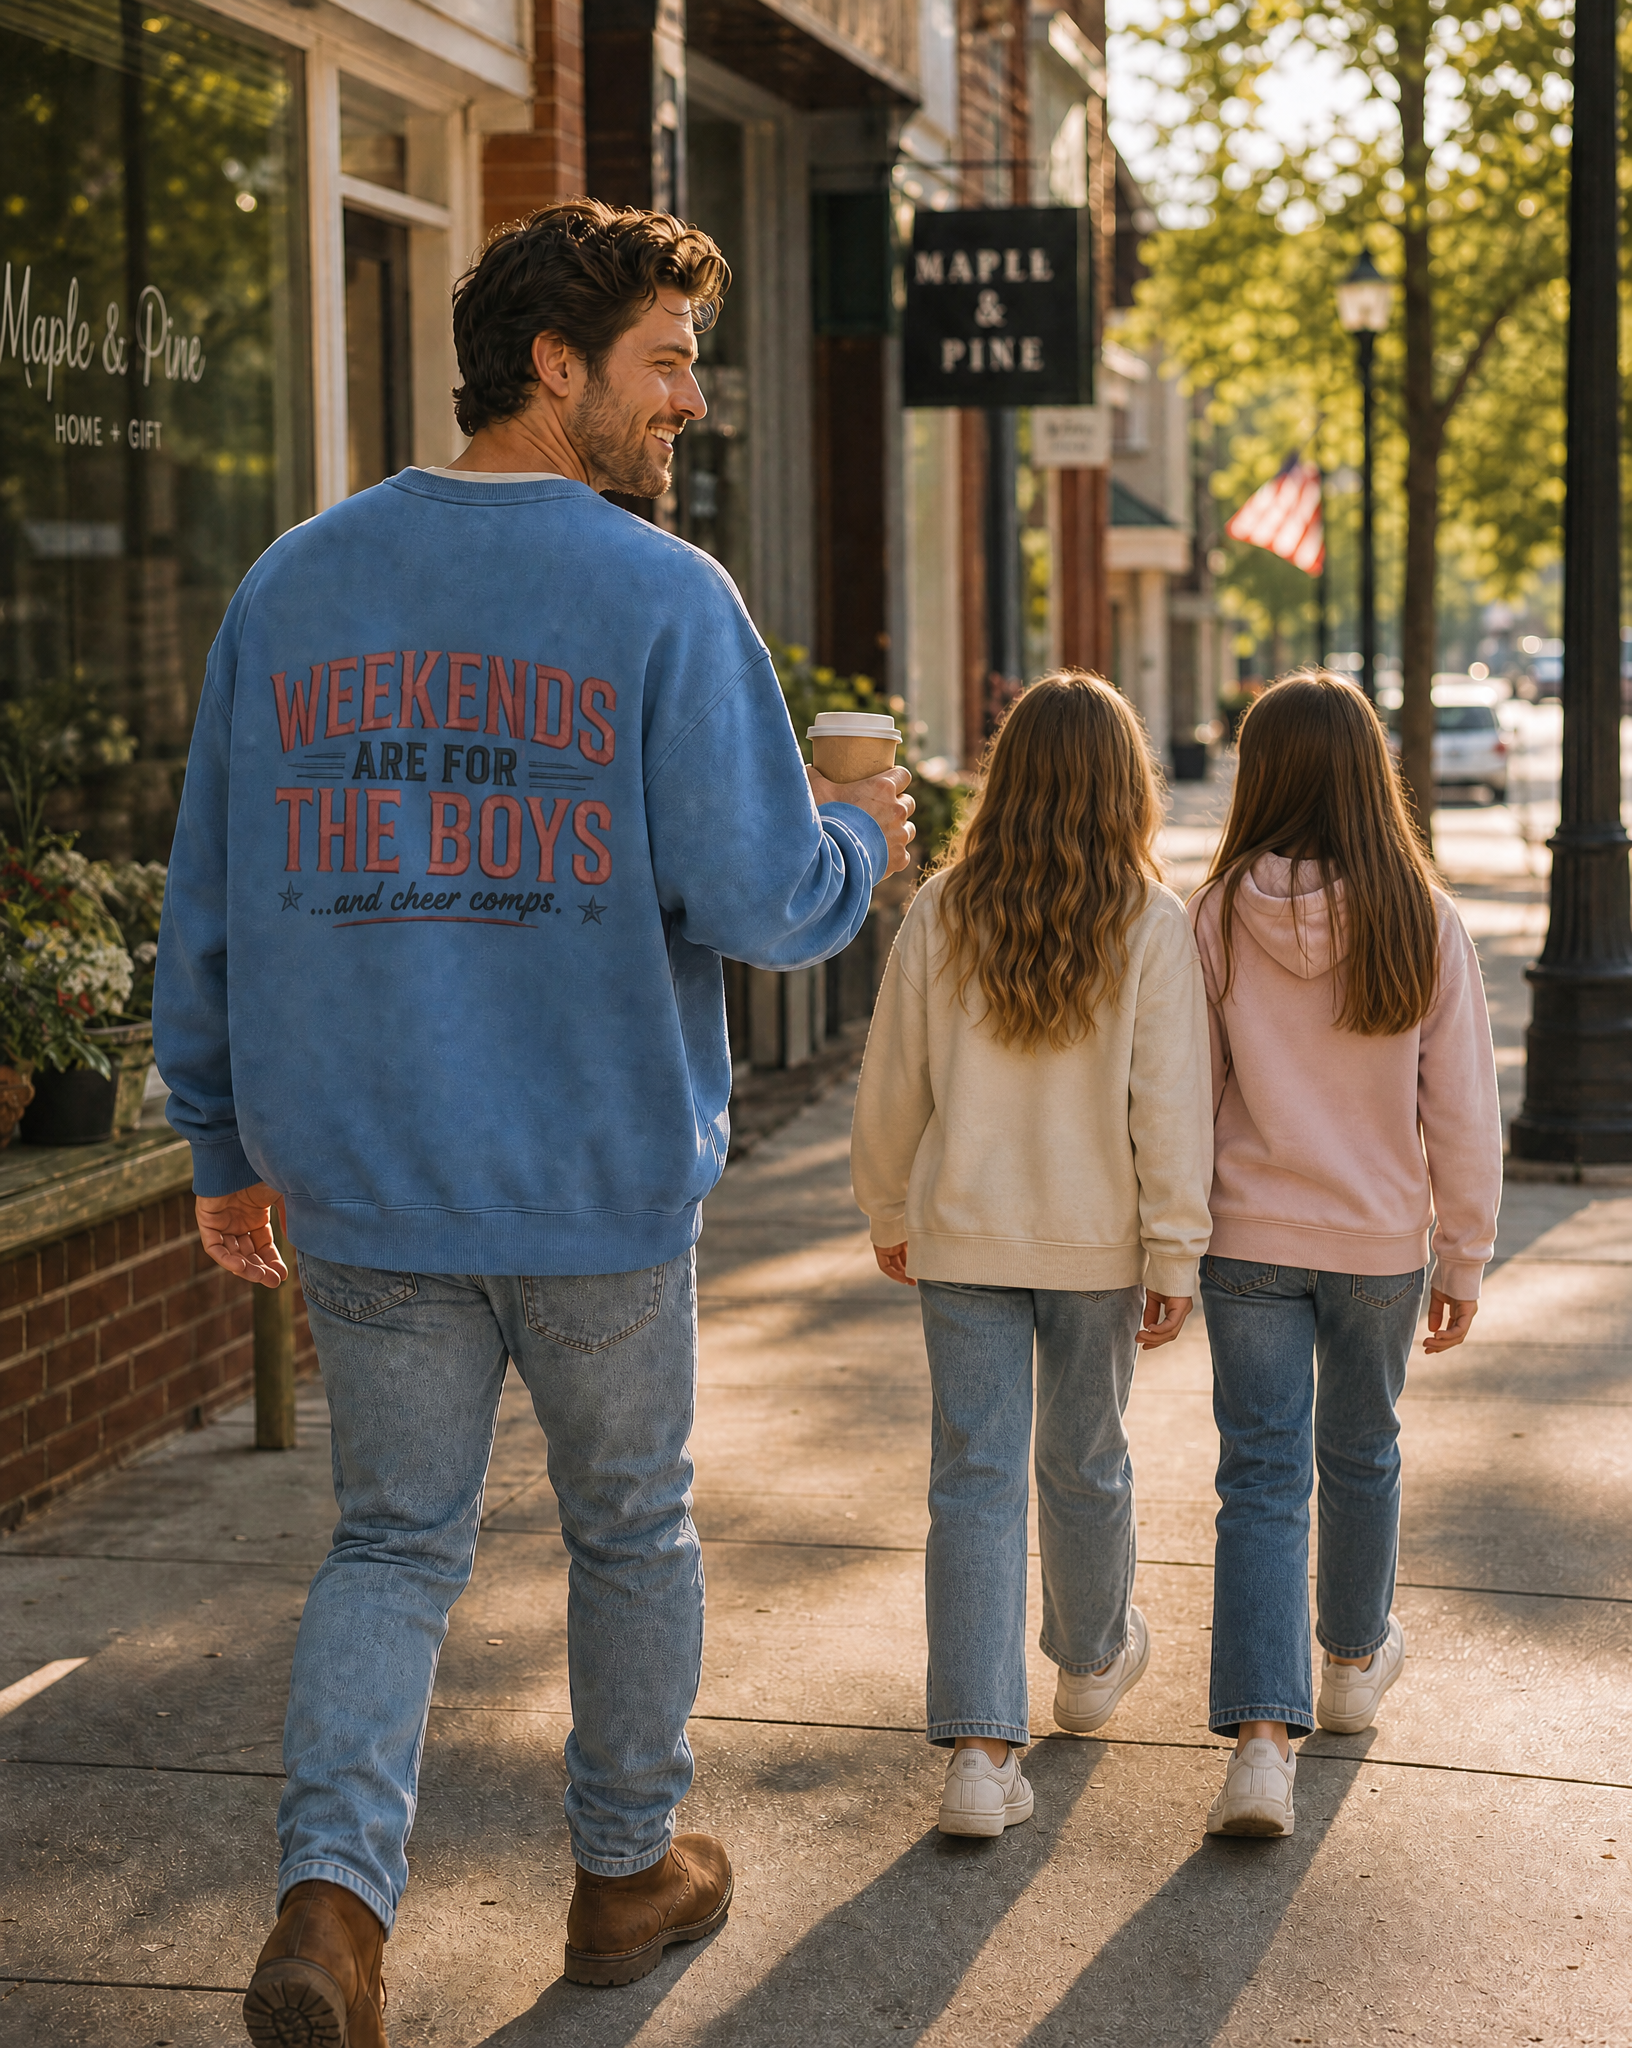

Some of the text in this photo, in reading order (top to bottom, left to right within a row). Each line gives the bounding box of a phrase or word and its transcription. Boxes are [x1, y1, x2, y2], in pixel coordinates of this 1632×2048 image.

[974, 288, 1007, 328] &
[0, 261, 206, 401] Maple & Pine
[940, 336, 1045, 373] PINE
[55, 413, 103, 446] HOME
[128, 418, 162, 450] GIFT
[270, 650, 617, 767] WEEKENDS
[352, 741, 518, 787] ARE FOR
[275, 787, 613, 886] THE BOYS
[390, 881, 461, 912] cheer
[469, 891, 562, 922] comps.
